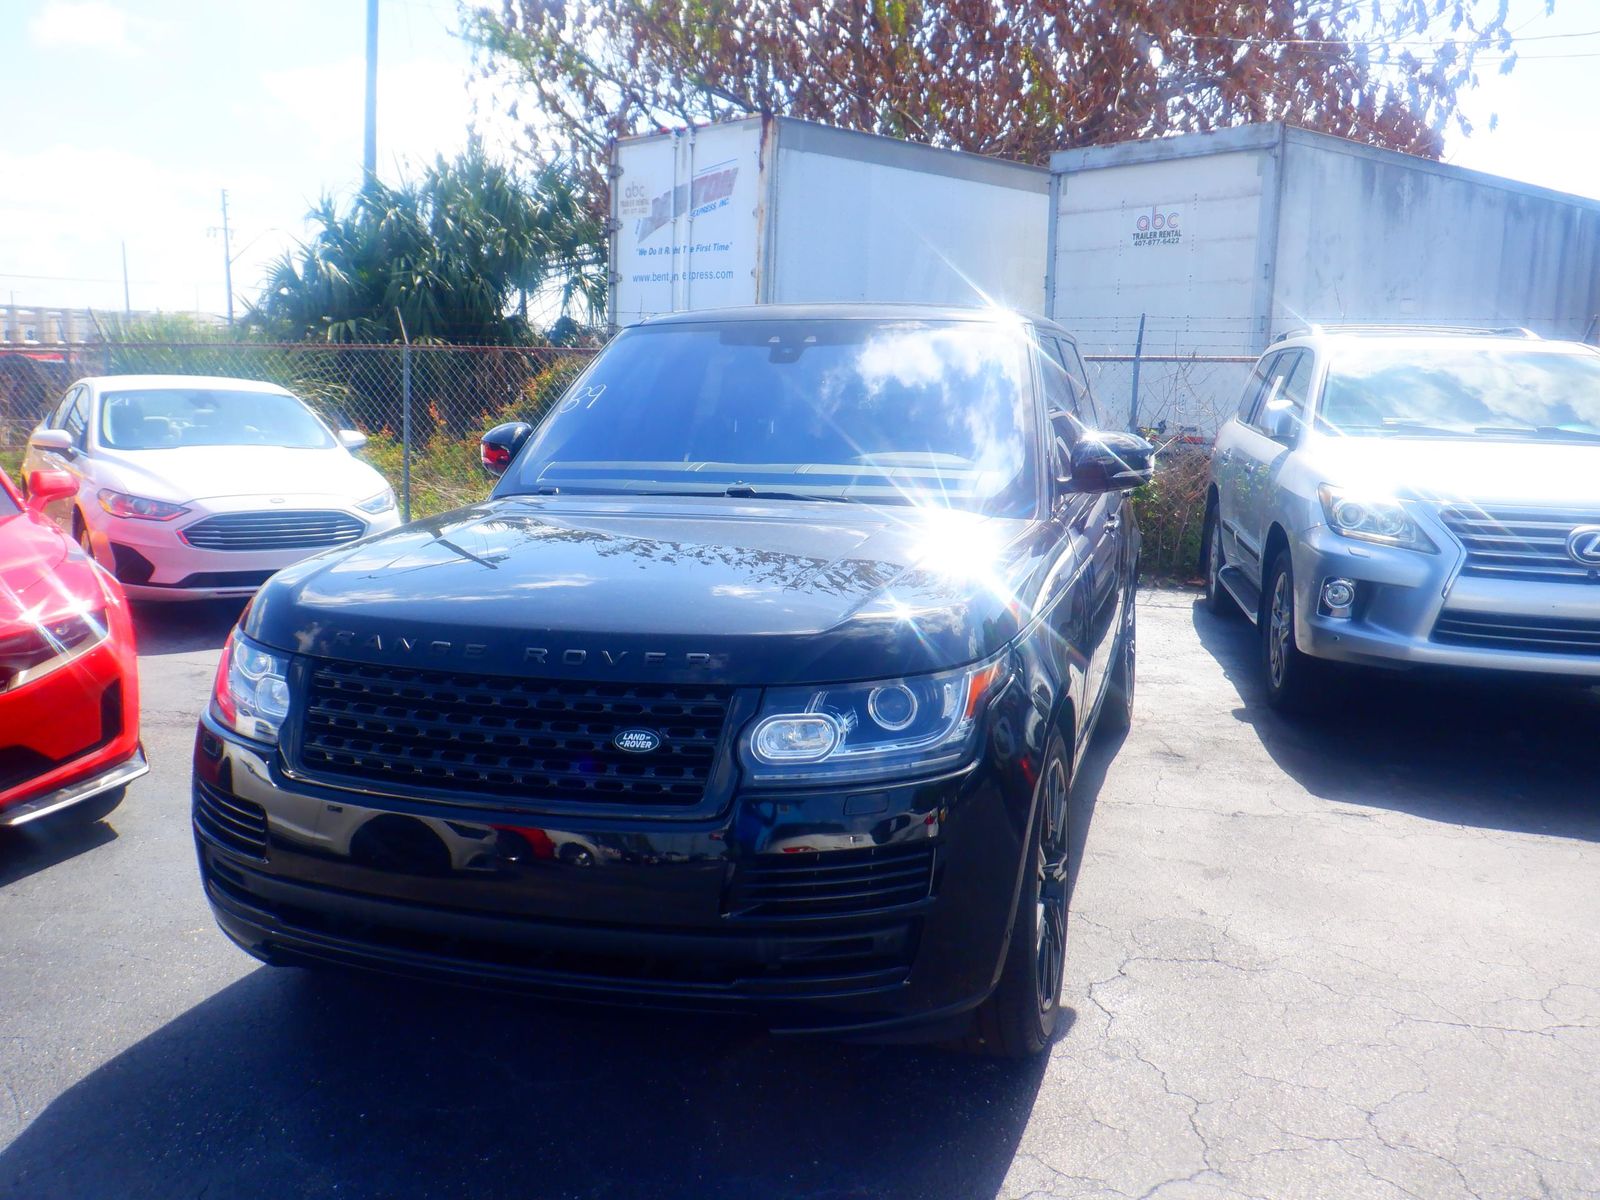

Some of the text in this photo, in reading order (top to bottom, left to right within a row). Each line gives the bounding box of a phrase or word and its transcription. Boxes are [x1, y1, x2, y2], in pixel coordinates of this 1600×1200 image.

[1136, 203, 1180, 231] abc
[1132, 229, 1182, 241] TRAILER RENTAL
[649, 247, 657, 256] Do
[682, 245, 695, 254] Te
[696, 242, 711, 253] First
[523, 647, 712, 672] ROVER
[622, 733, 646, 741] LAND
[623, 740, 652, 749] ROVER
